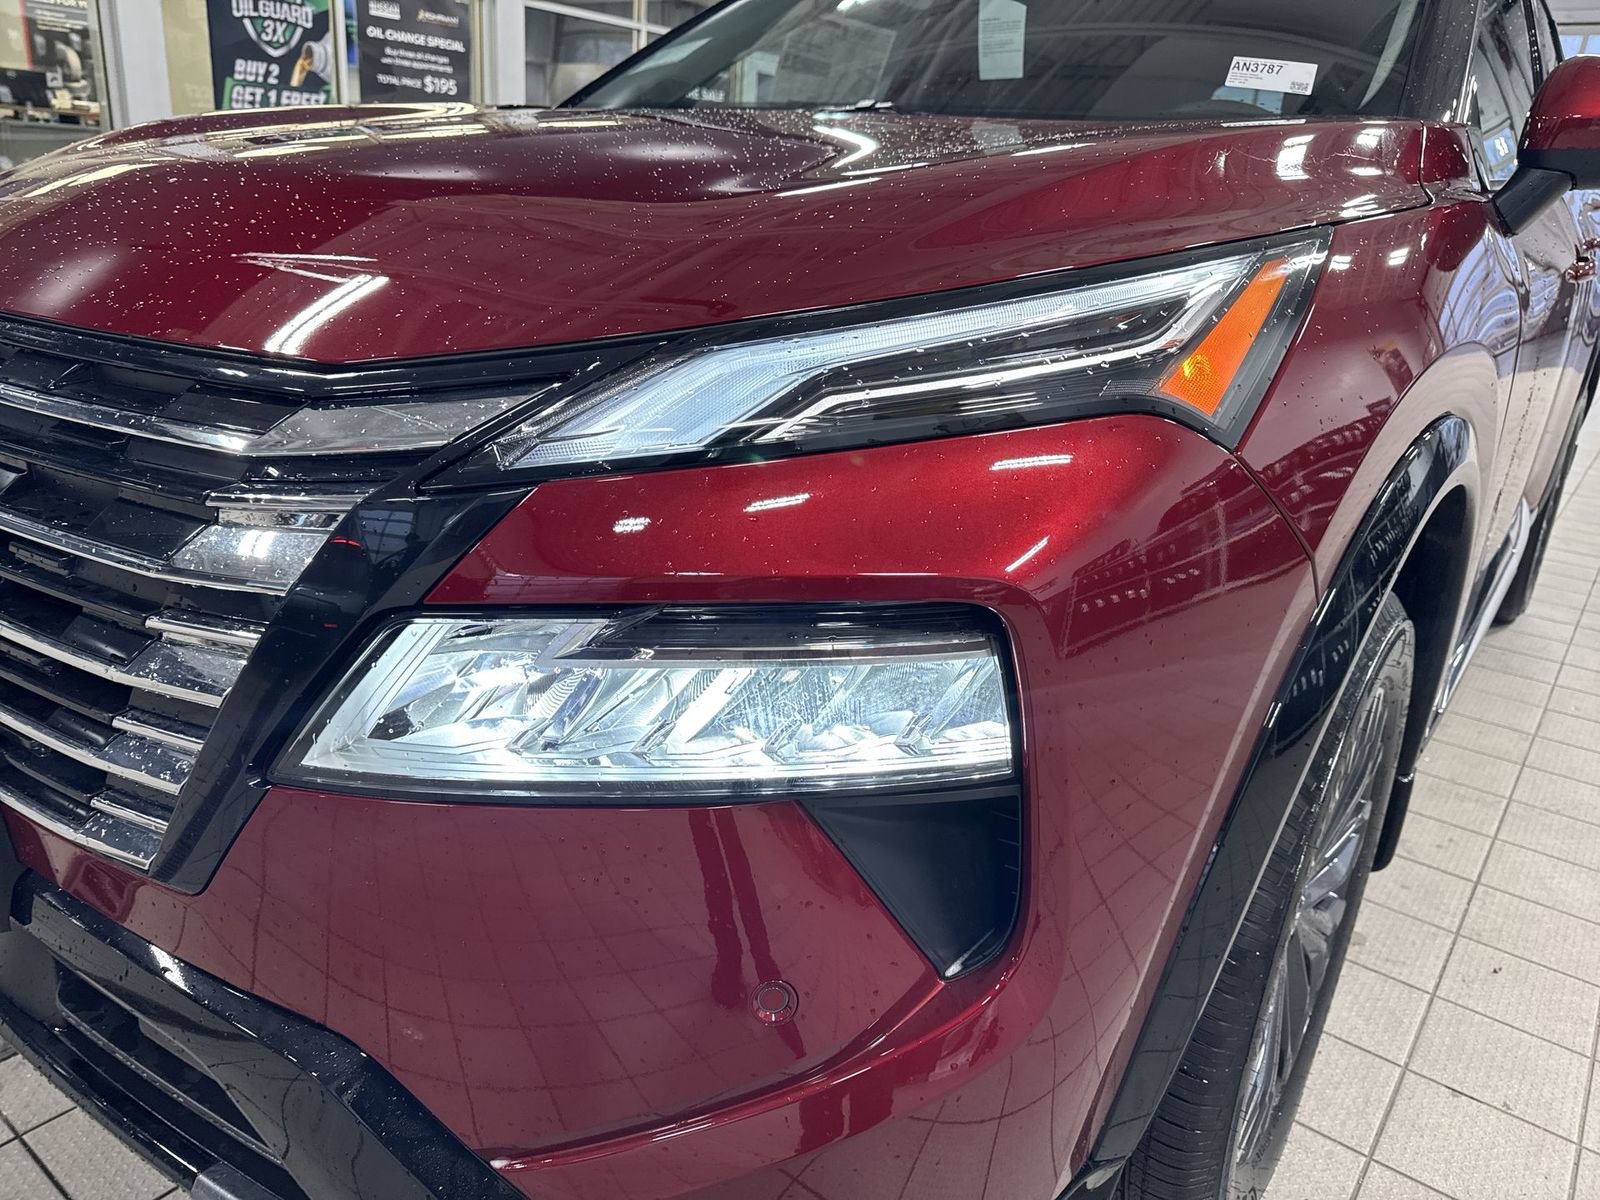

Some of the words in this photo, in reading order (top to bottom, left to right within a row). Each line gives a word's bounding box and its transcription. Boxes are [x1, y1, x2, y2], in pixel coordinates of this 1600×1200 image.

[261, 20, 285, 43] 3X
[366, 25, 385, 39] OIL
[385, 28, 426, 46] CHANGE
[427, 35, 466, 52] SPECIAL
[234, 59, 267, 83] BUY
[267, 63, 280, 84] 2
[1232, 61, 1283, 75] AN3787
[423, 75, 458, 95] $195
[232, 86, 264, 109] GET
[268, 88, 278, 107] 1
